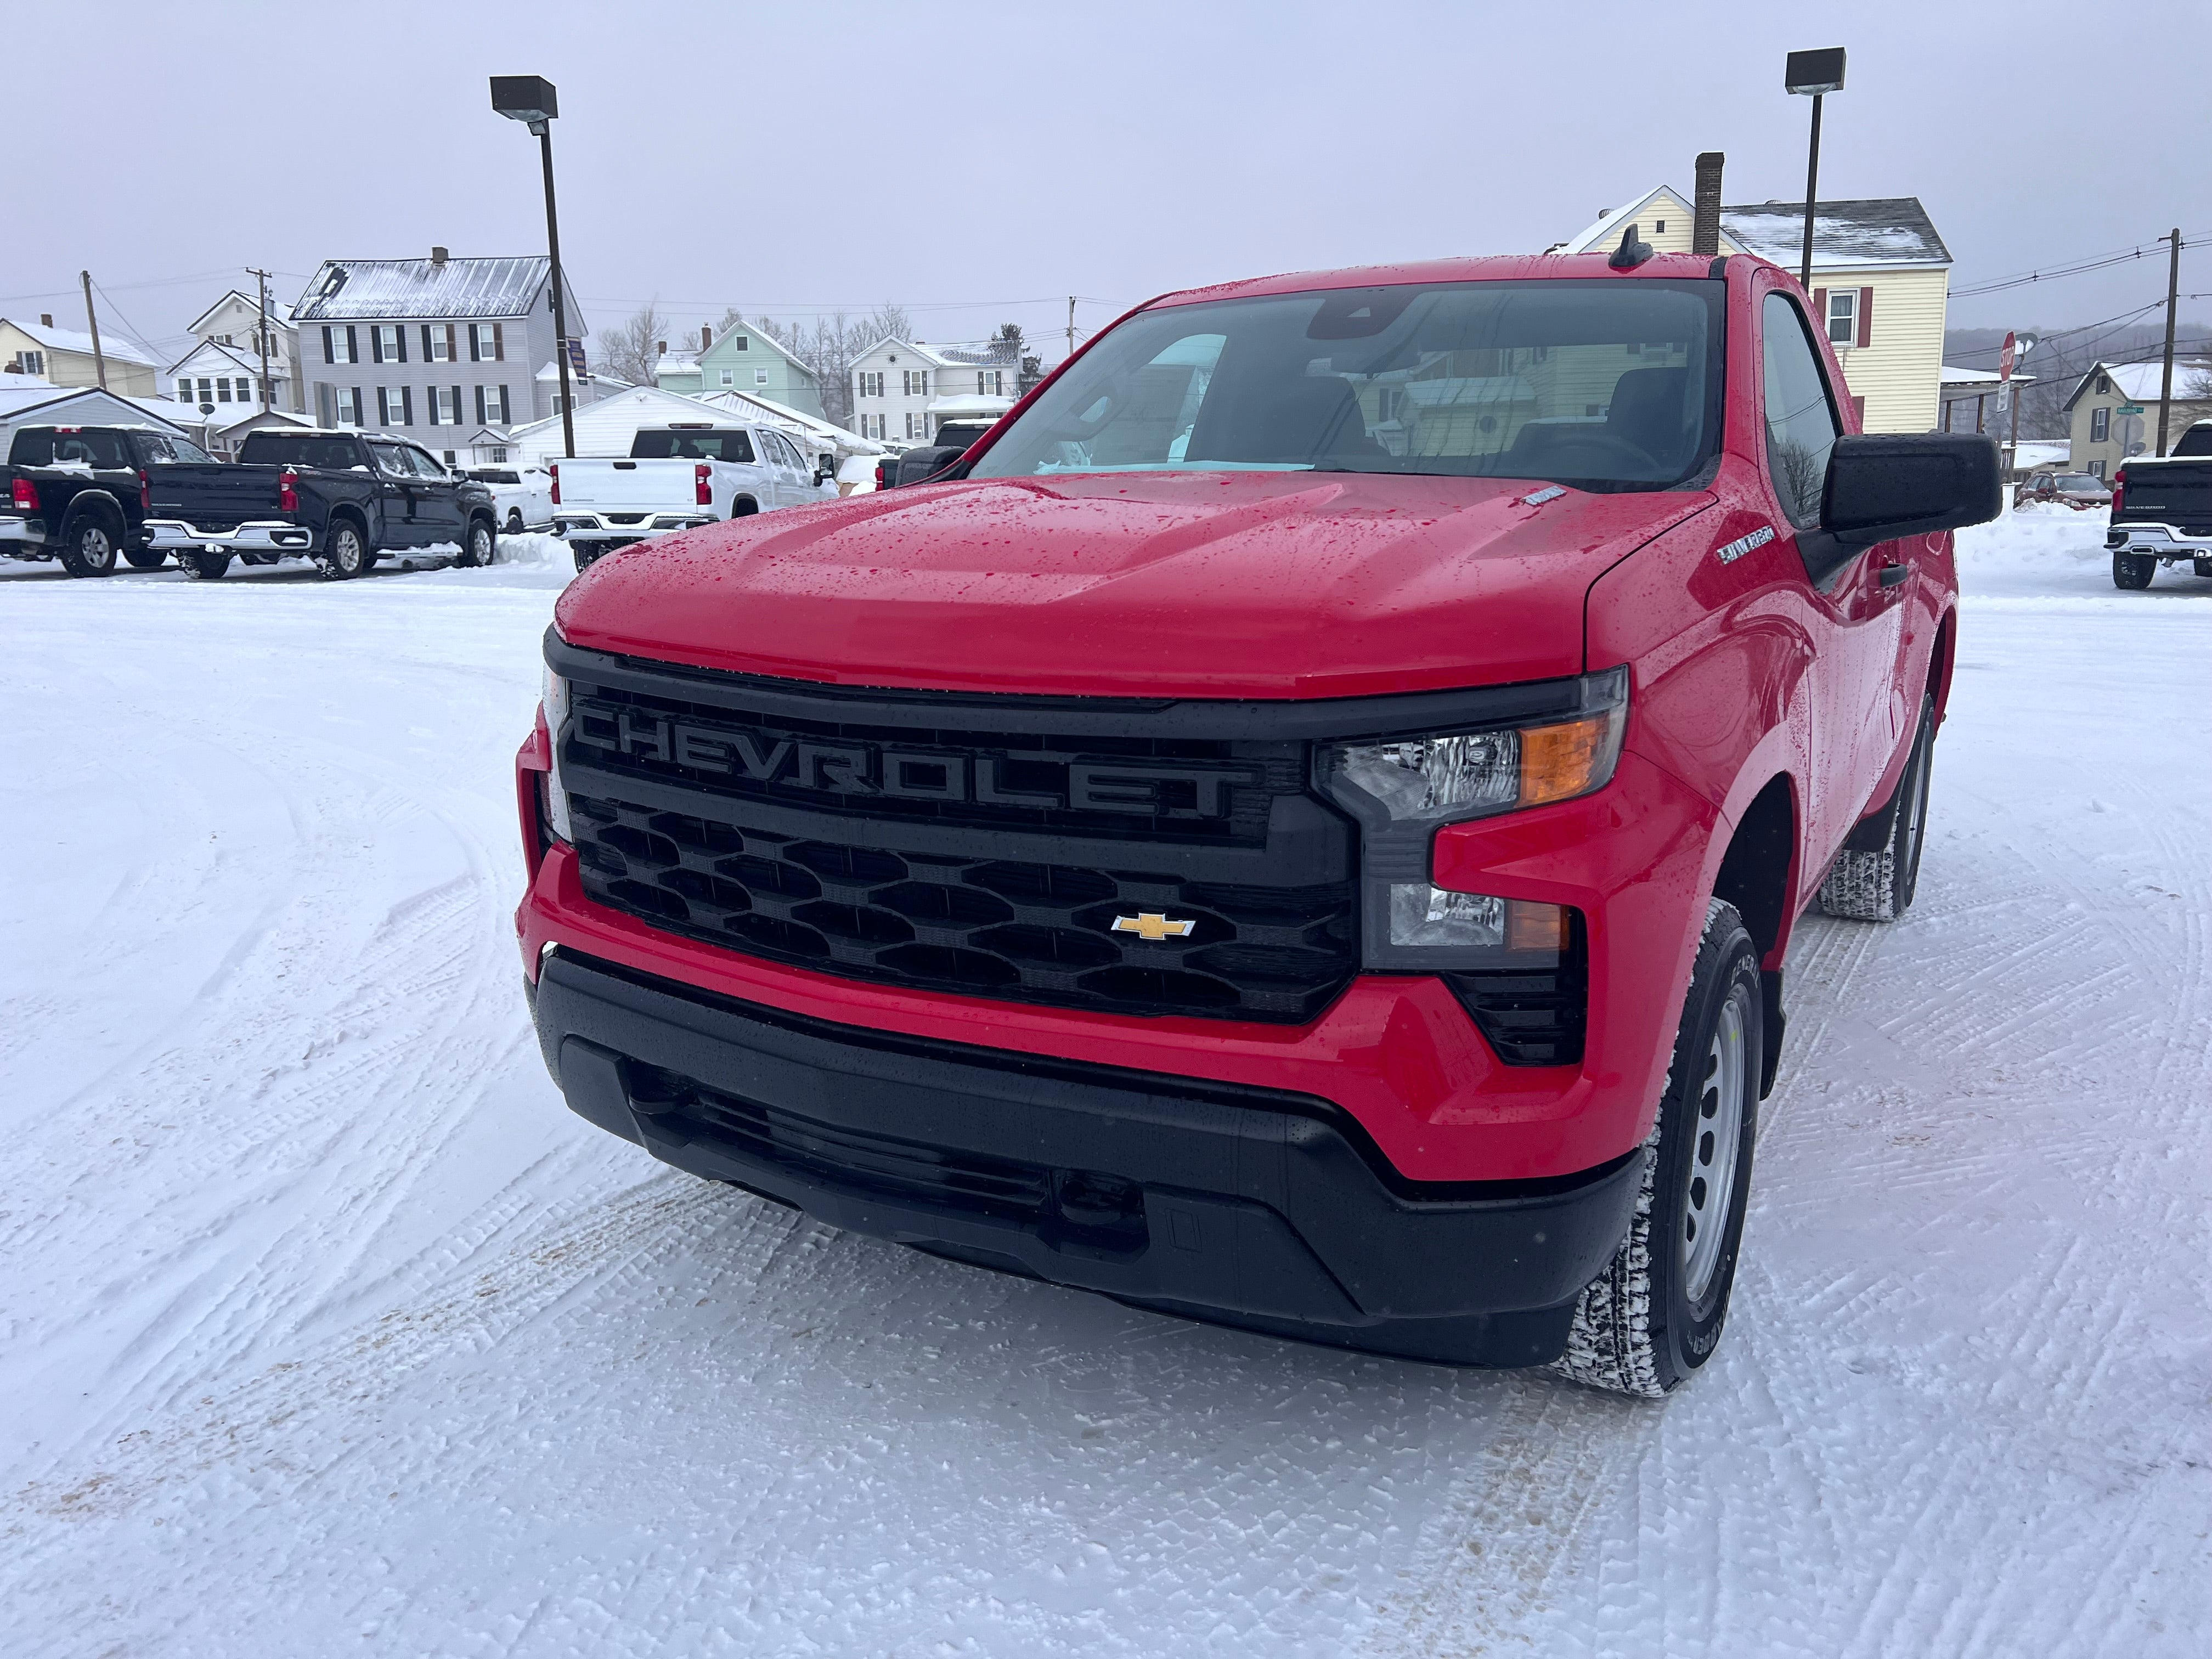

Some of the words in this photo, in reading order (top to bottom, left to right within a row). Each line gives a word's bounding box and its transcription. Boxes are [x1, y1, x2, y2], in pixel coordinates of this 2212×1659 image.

[2001, 346, 2015, 367] STOP
[574, 704, 1254, 817] CHEVROLET
[1731, 955, 1759, 988] GENERAL
